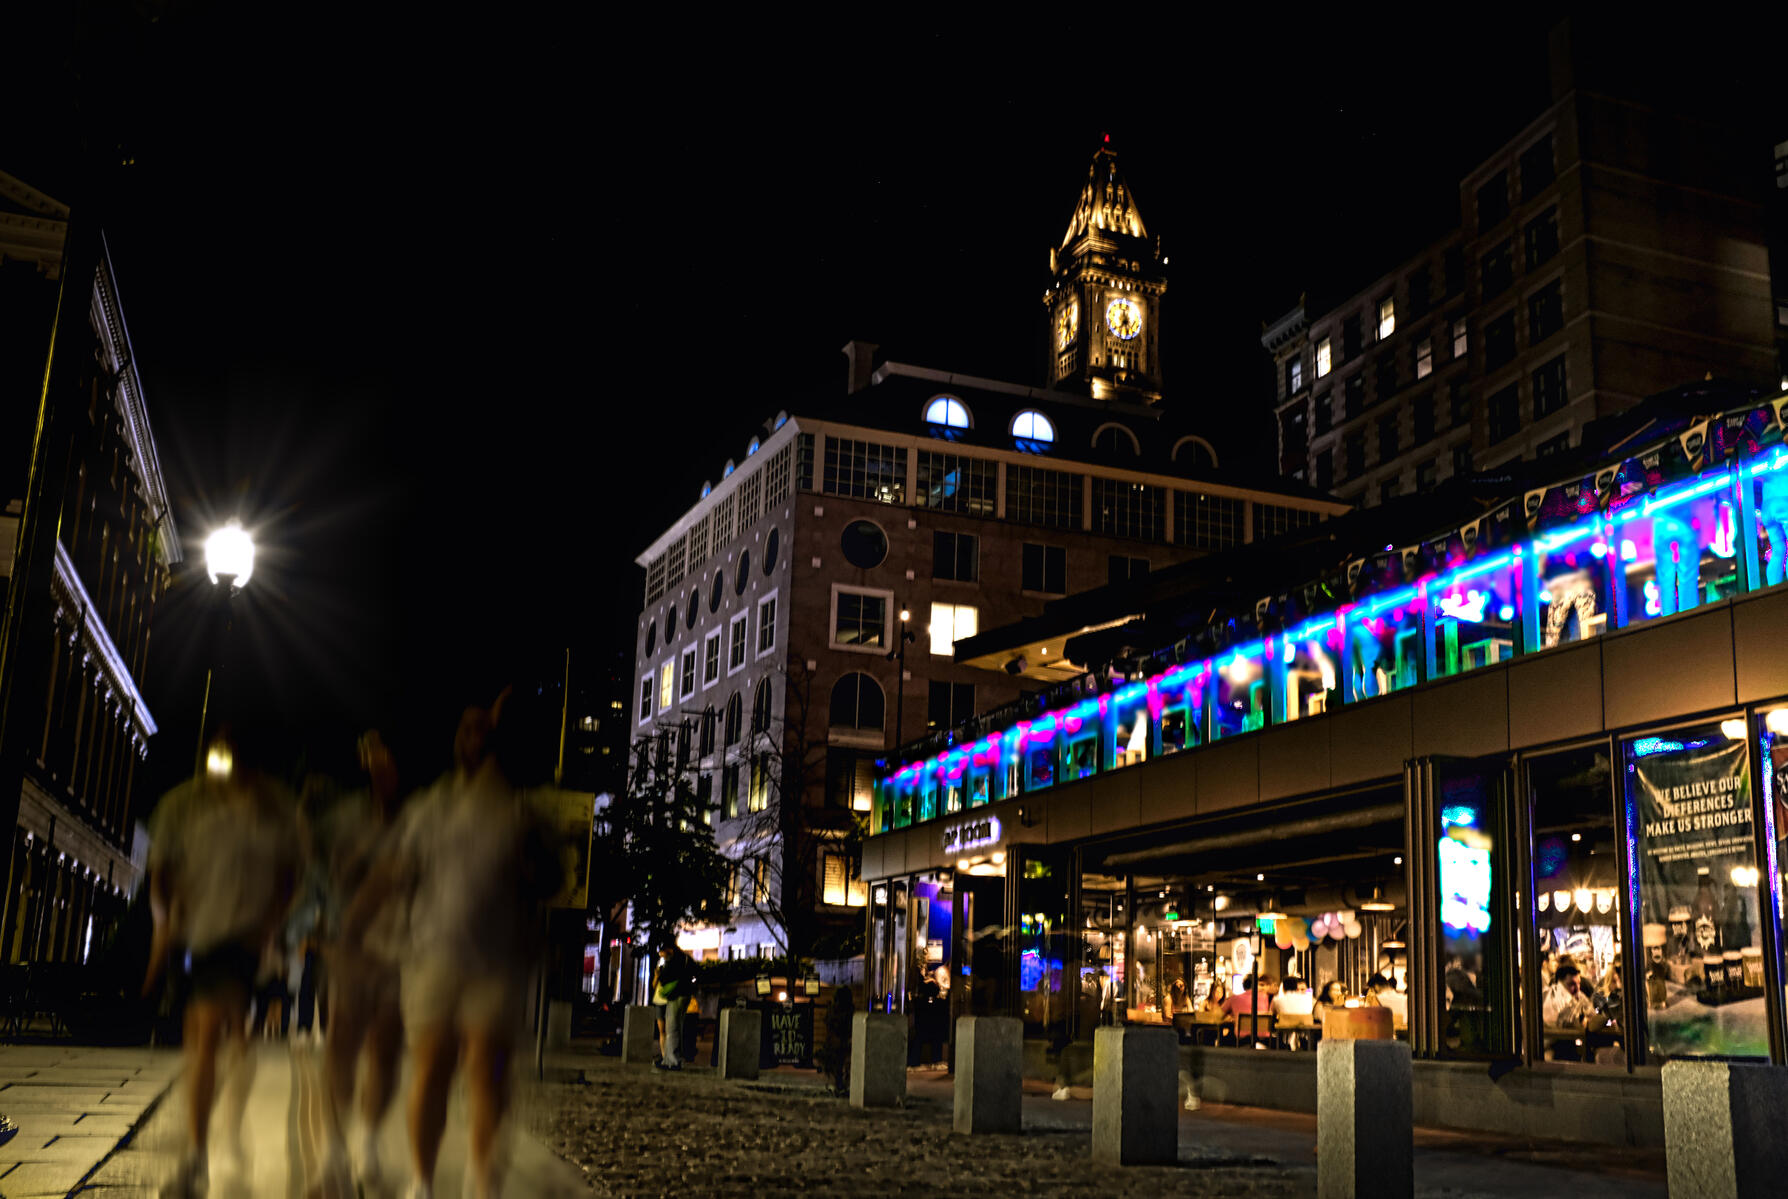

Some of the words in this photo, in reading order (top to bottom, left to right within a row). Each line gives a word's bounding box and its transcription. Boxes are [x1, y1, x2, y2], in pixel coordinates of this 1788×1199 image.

[1673, 780, 1716, 801] BELIEVE
[1719, 776, 1740, 792] OUR
[1663, 794, 1734, 818] DIFFERENCES
[1646, 820, 1675, 838] MAKE
[1677, 817, 1692, 833] US
[1694, 809, 1752, 831] STRONGER
[771, 1013, 800, 1030] HAVE
[774, 1041, 806, 1056] READY
